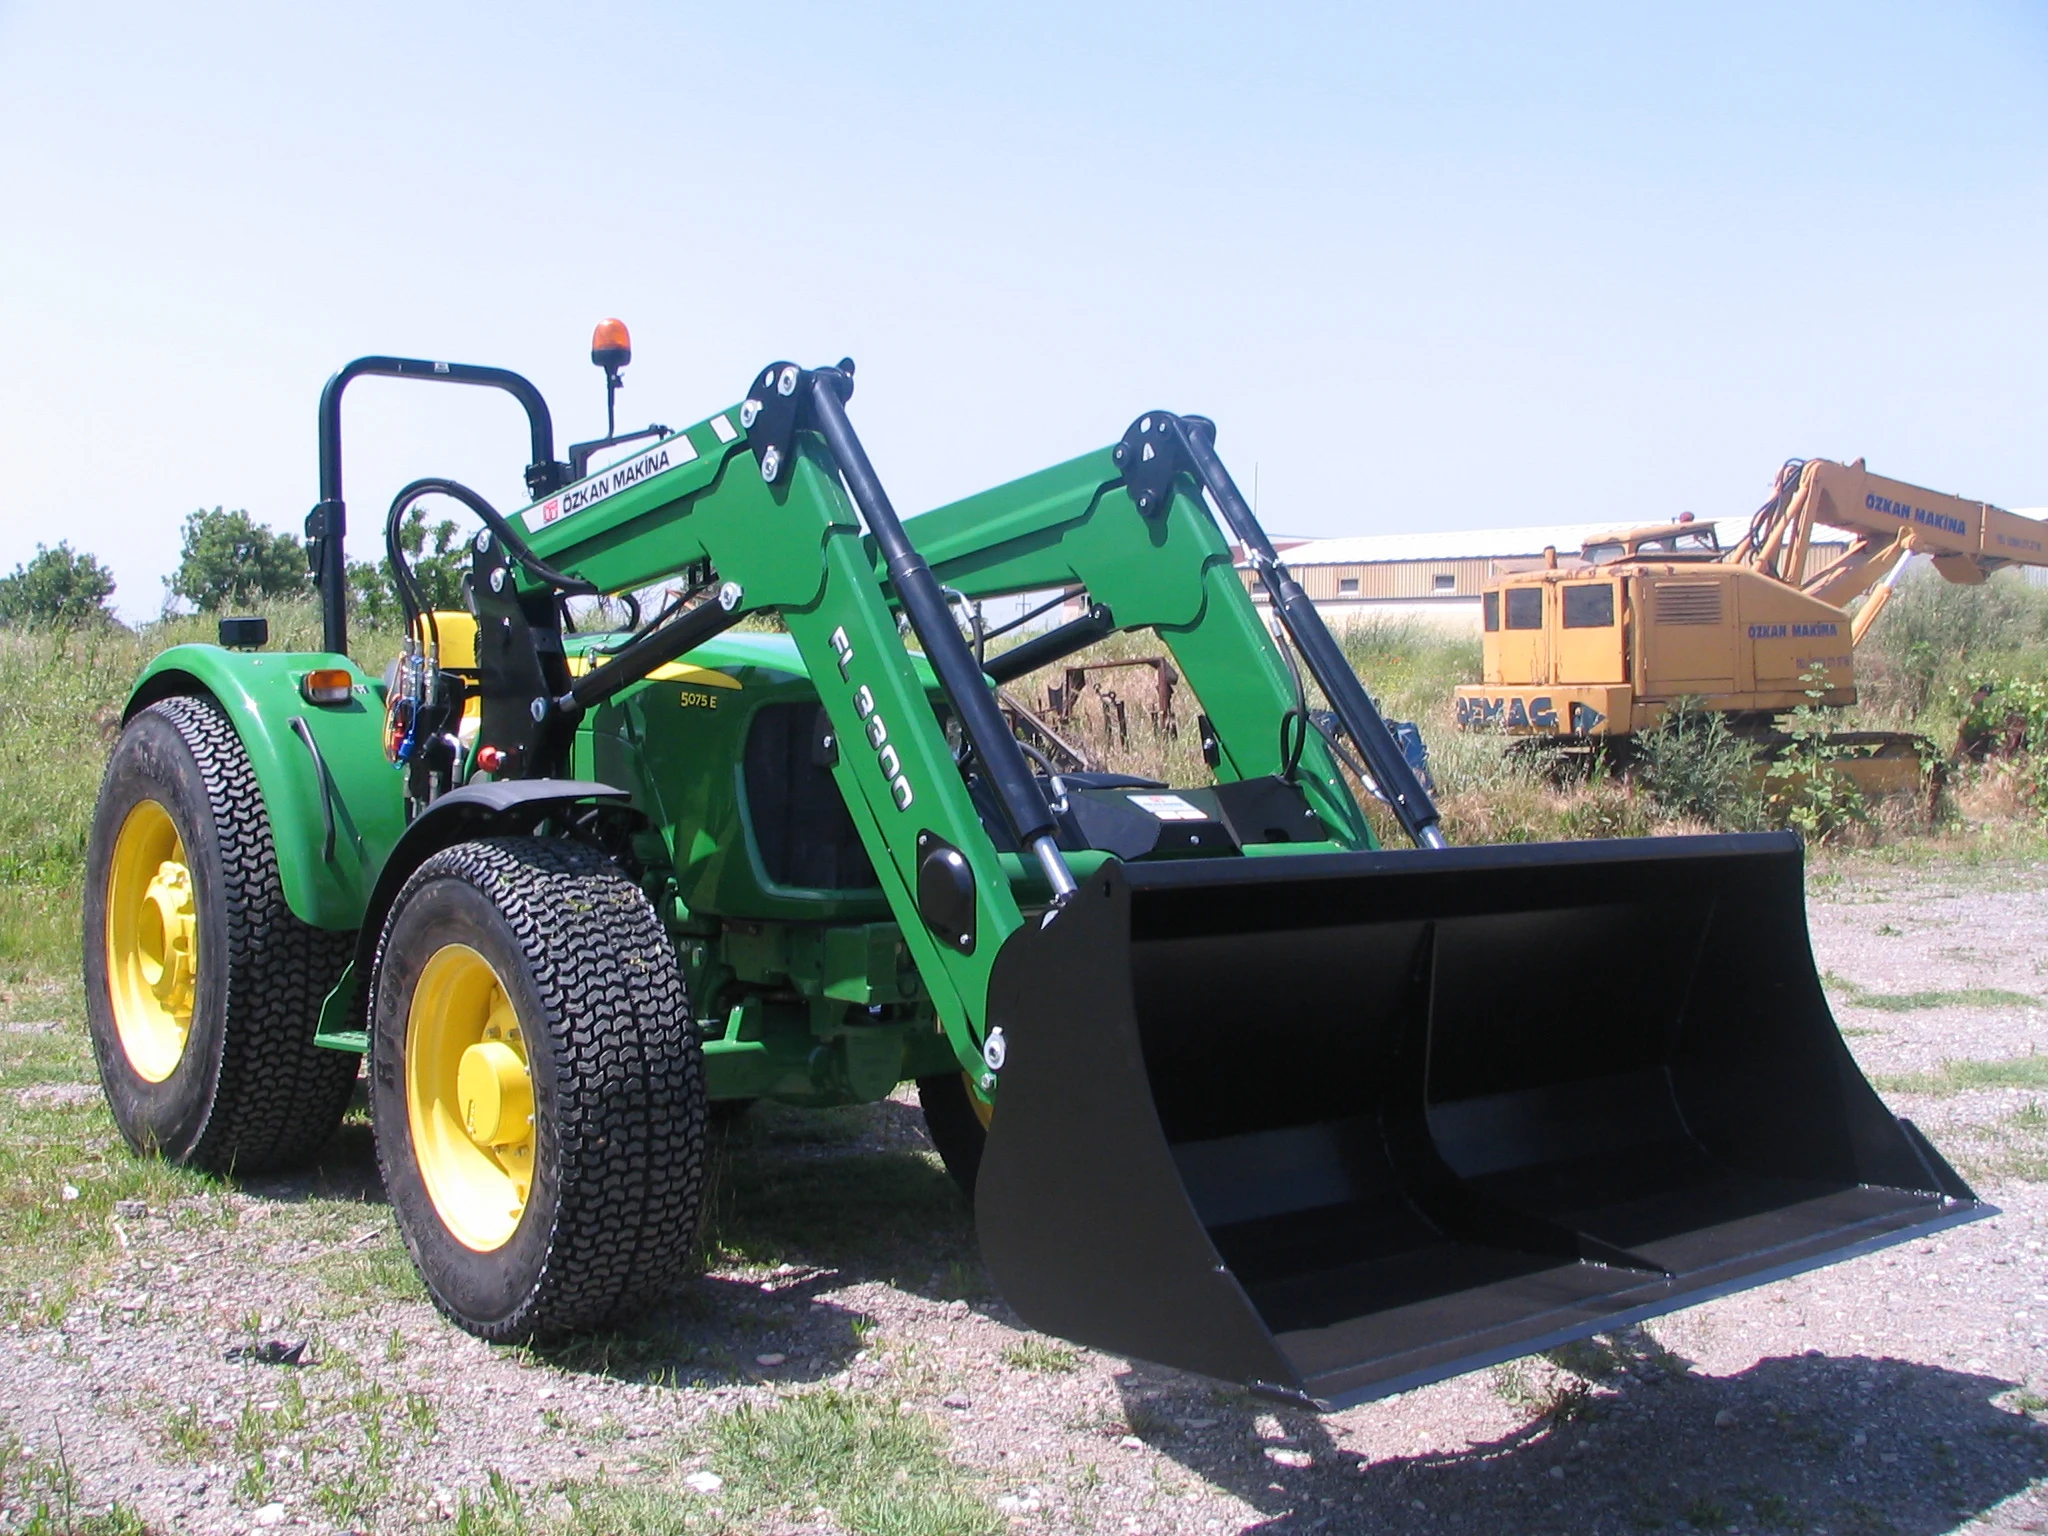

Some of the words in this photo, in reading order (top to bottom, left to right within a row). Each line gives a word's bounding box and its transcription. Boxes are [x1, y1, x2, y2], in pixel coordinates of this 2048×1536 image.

[563, 477, 610, 514] ÖZKAN
[613, 450, 670, 492] MAKİNA
[1915, 507, 1966, 536] MAKİNA
[680, 691, 708, 707] 5075
[710, 695, 717, 708] E
[828, 625, 854, 684] FL
[853, 684, 914, 812] 3300
